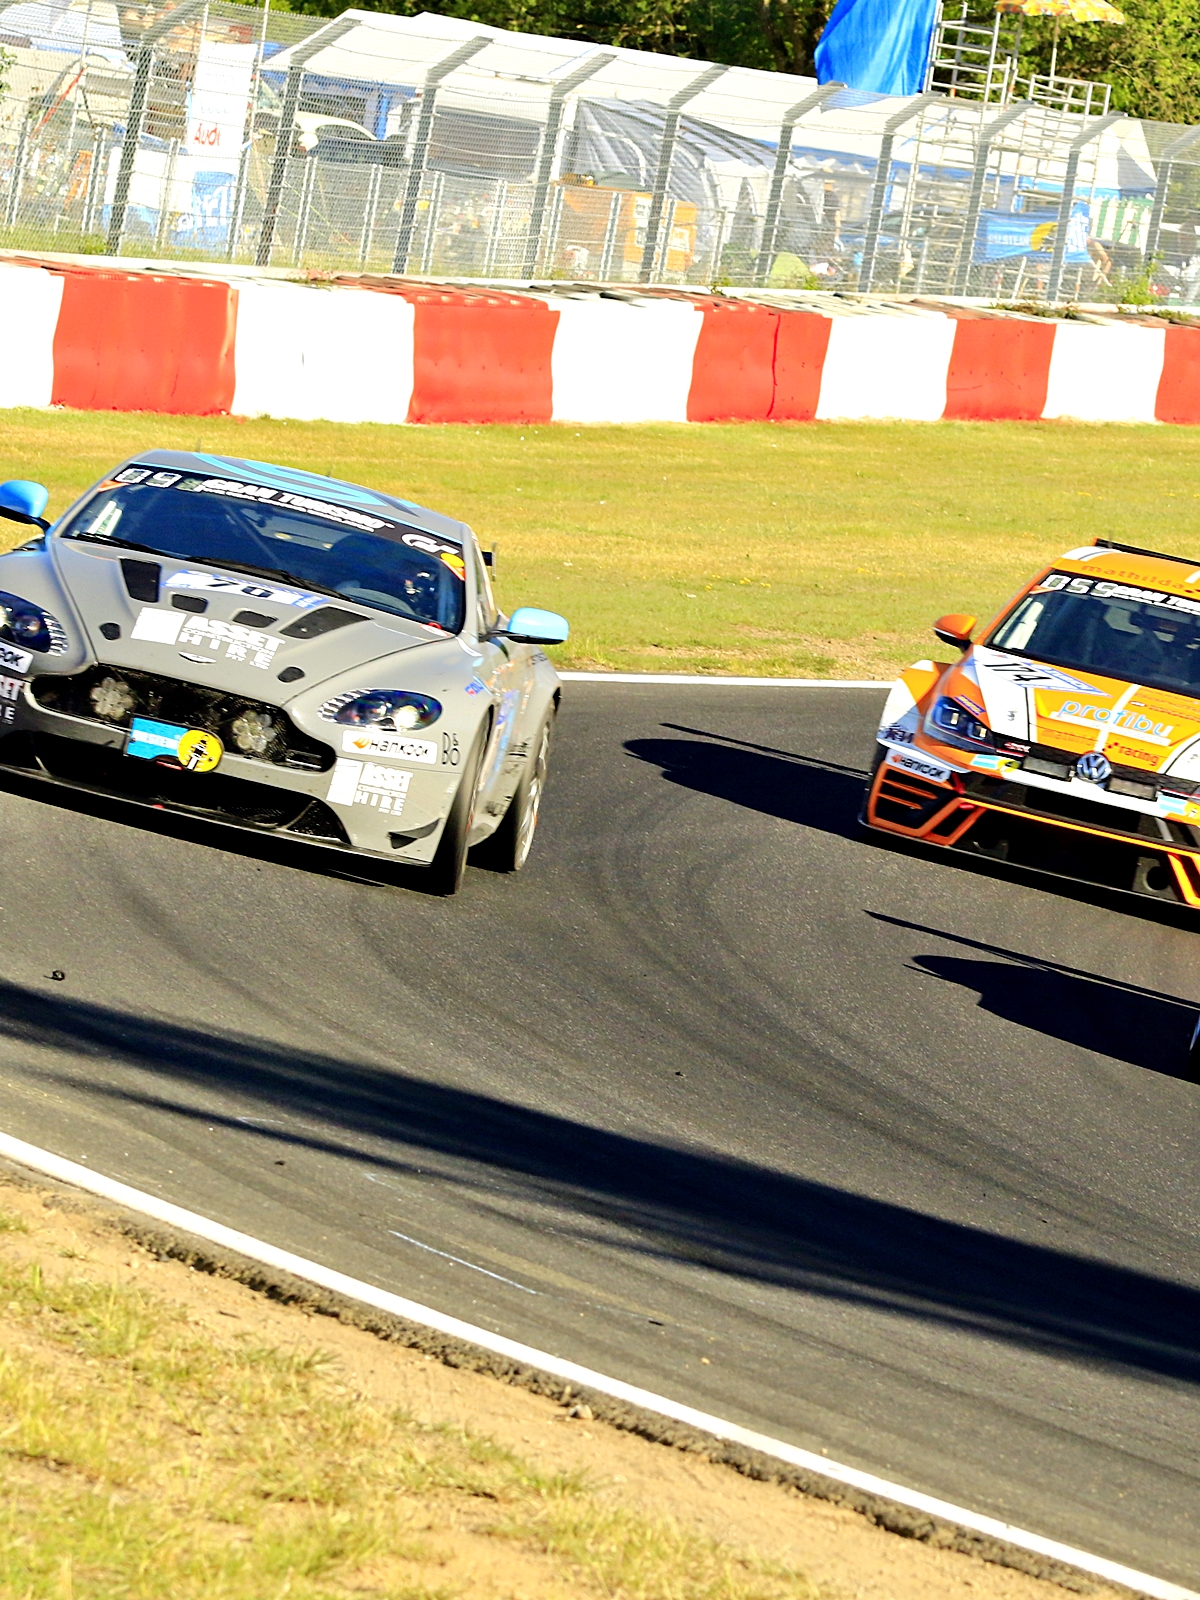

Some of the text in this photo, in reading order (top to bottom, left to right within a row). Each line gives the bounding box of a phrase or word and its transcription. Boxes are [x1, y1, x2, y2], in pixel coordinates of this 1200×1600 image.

[1081, 564, 1186, 590] mathilda
[184, 615, 286, 651] ASSET
[178, 631, 273, 666] HIRE
[982, 662, 1053, 682] 174
[1056, 700, 1174, 738] profibu
[1117, 743, 1160, 767] racing
[353, 790, 406, 812] HIRE
